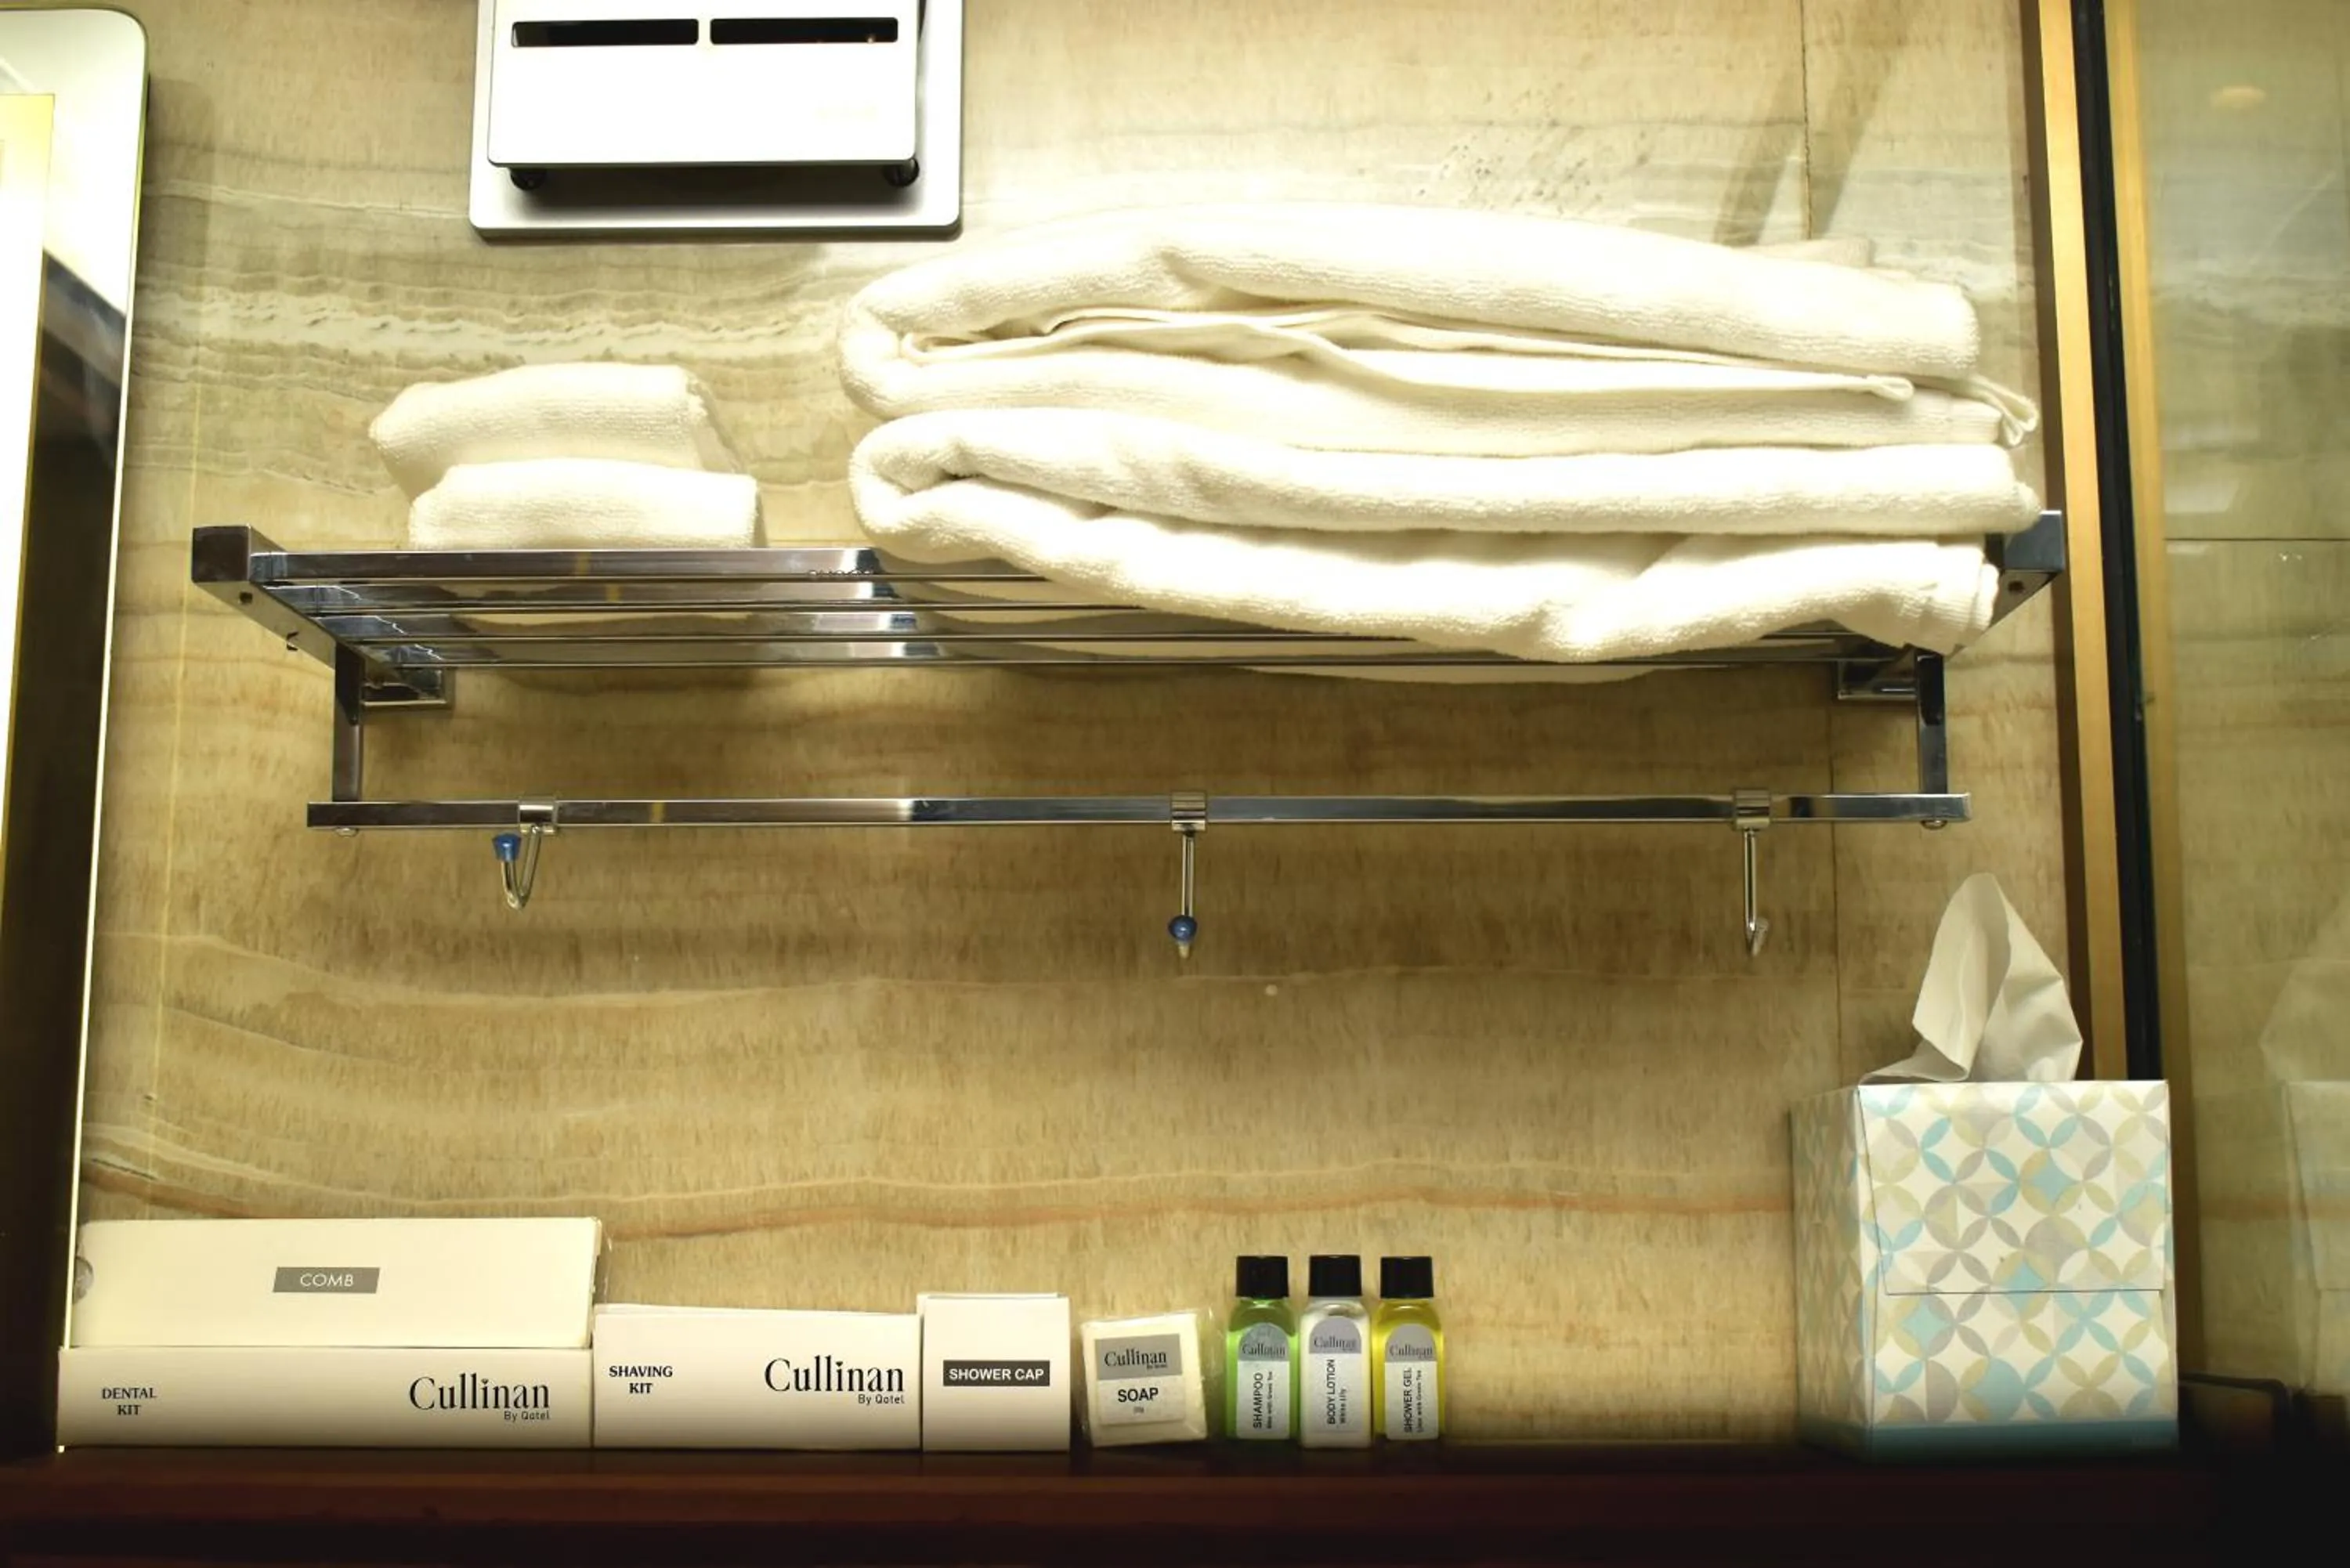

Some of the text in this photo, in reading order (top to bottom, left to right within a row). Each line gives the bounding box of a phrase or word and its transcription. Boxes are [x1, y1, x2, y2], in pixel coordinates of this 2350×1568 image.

[299, 1272, 354, 1287] COMB
[1104, 1347, 1167, 1367] Cullinan
[609, 1365, 674, 1378] SHAVING
[765, 1354, 905, 1393] Cullinan
[949, 1367, 1045, 1381] SHOWER CAP
[101, 1386, 157, 1400] DENTAL
[408, 1372, 550, 1411] Cullinan
[629, 1382, 653, 1394] KIT
[1117, 1387, 1159, 1403] SOAP
[1326, 1359, 1336, 1425] BODY LOTION
[858, 1393, 873, 1406] By
[1253, 1372, 1264, 1429] SHAMPOO
[1403, 1367, 1413, 1433] SHOWER GEL
[117, 1404, 142, 1416] KIT
[504, 1411, 518, 1423] By
